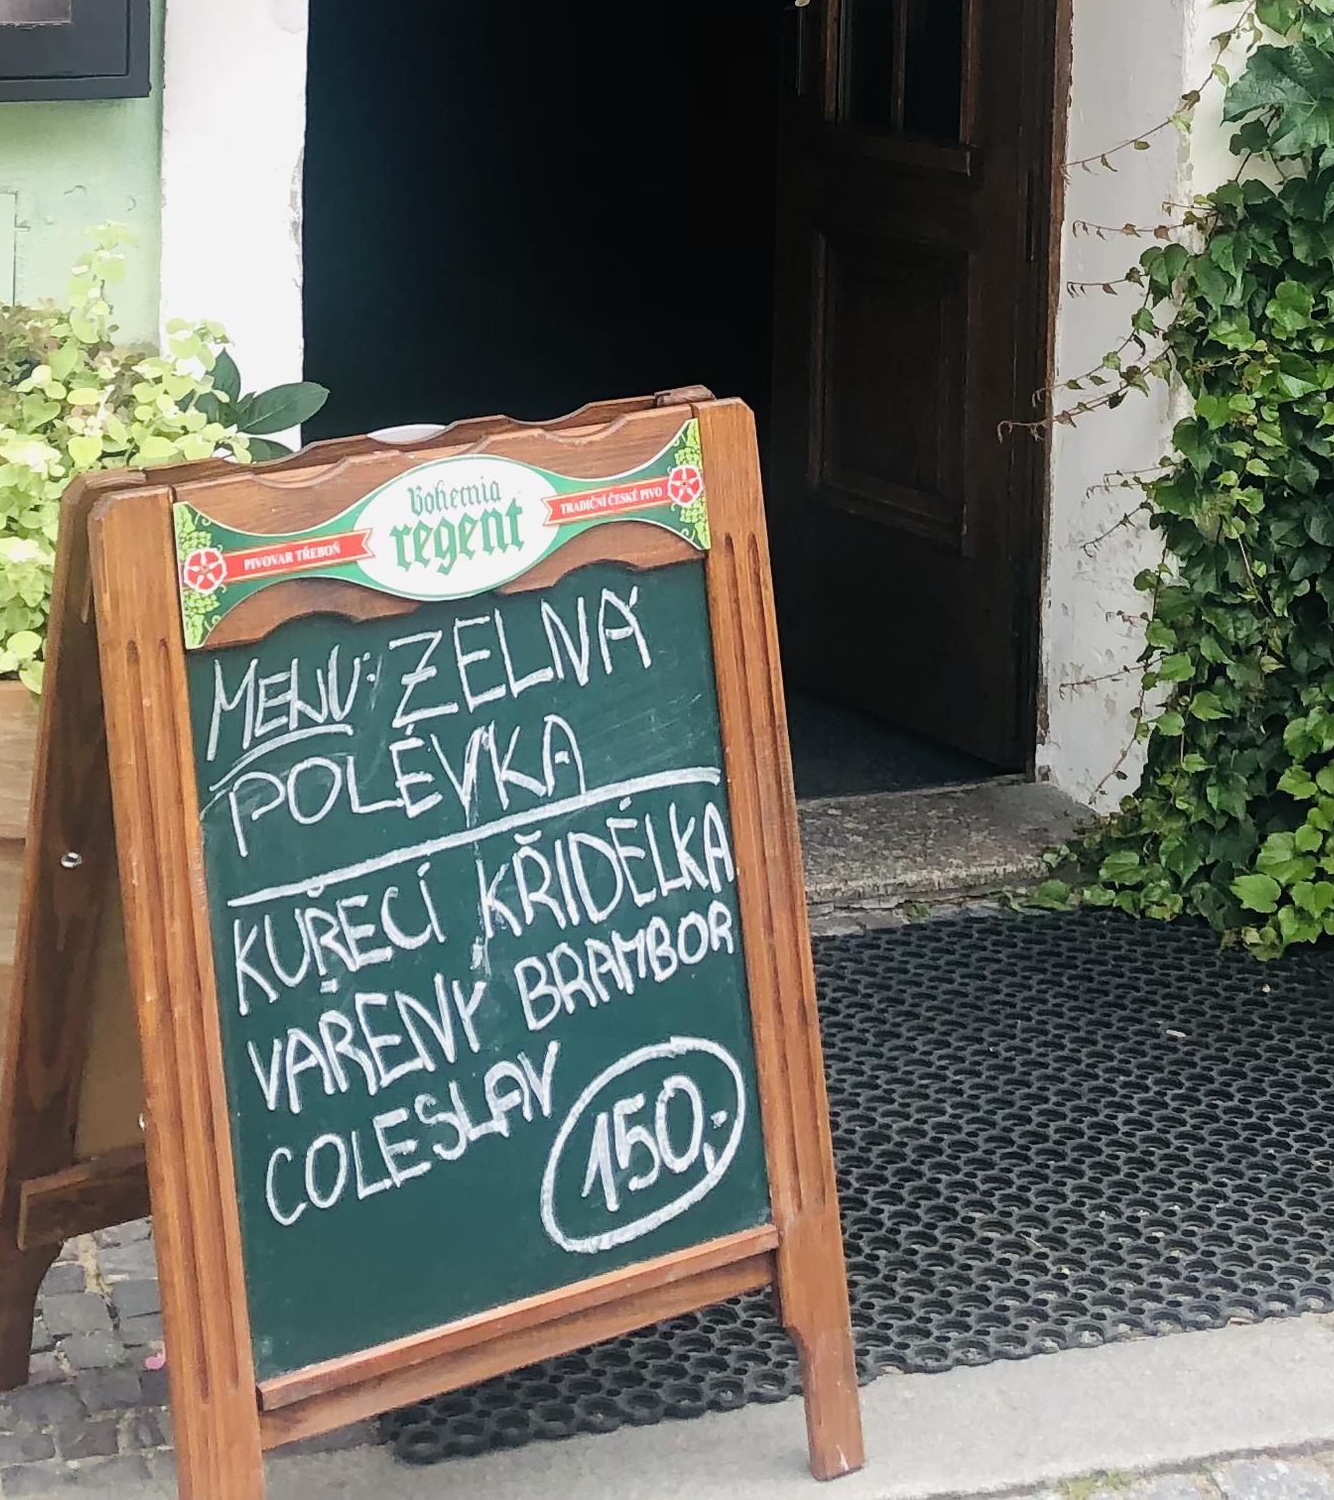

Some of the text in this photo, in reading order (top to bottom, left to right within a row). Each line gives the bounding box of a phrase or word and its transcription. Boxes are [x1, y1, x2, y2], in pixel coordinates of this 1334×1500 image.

[389, 497, 525, 577] regent
[406, 475, 502, 517] Bohemia
[560, 486, 663, 516] TRADIČNÍ ČESKÉ PIVO
[243, 540, 341, 572] PIVOVAR TŘEBOŇ
[206, 585, 652, 761] MENU: ZELNÁ
[226, 713, 587, 859] POLÉVKA
[513, 898, 735, 1031] BRAMBOR
[265, 1039, 561, 1227] COLESLAV
